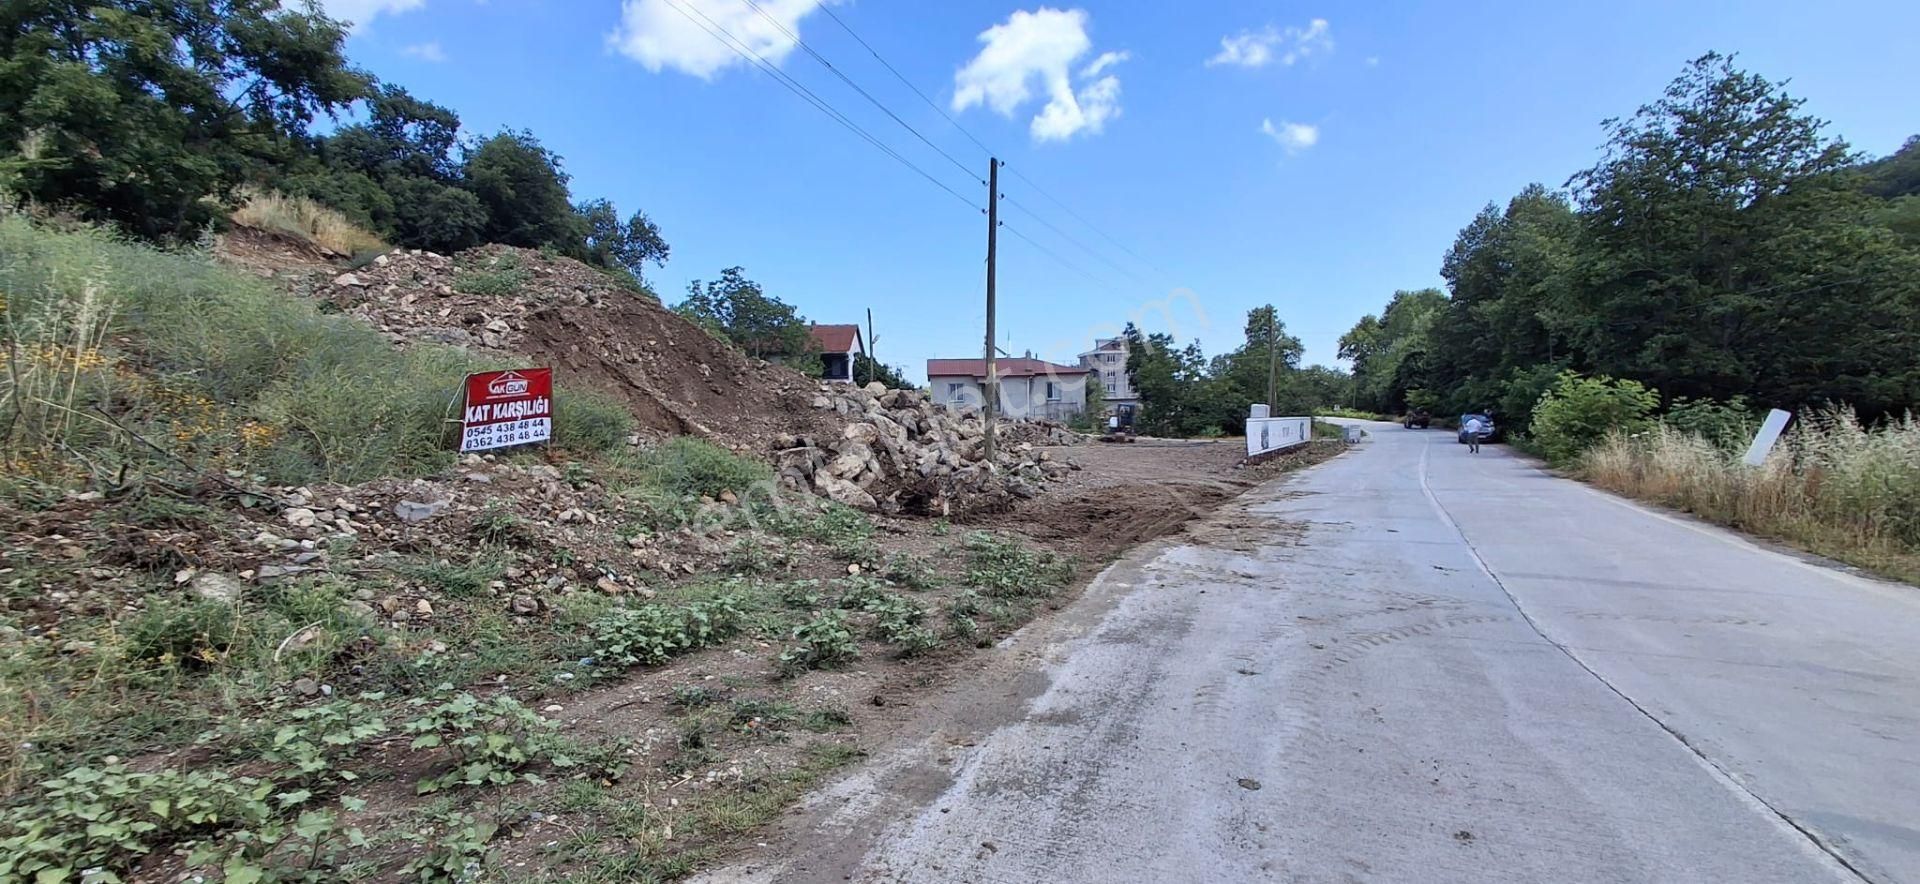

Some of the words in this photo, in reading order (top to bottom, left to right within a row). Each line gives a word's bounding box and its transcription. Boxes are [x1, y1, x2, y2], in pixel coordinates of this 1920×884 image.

[466, 405, 490, 422] KAT
[493, 396, 549, 420] KARŞILIĞI
[466, 427, 492, 438] 0545
[496, 423, 515, 433] 438
[518, 421, 529, 430] 48
[532, 419, 544, 427] 44
[466, 437, 492, 449] 0362
[496, 435, 515, 443] 438
[518, 431, 530, 440] 48
[533, 429, 545, 437] 44
